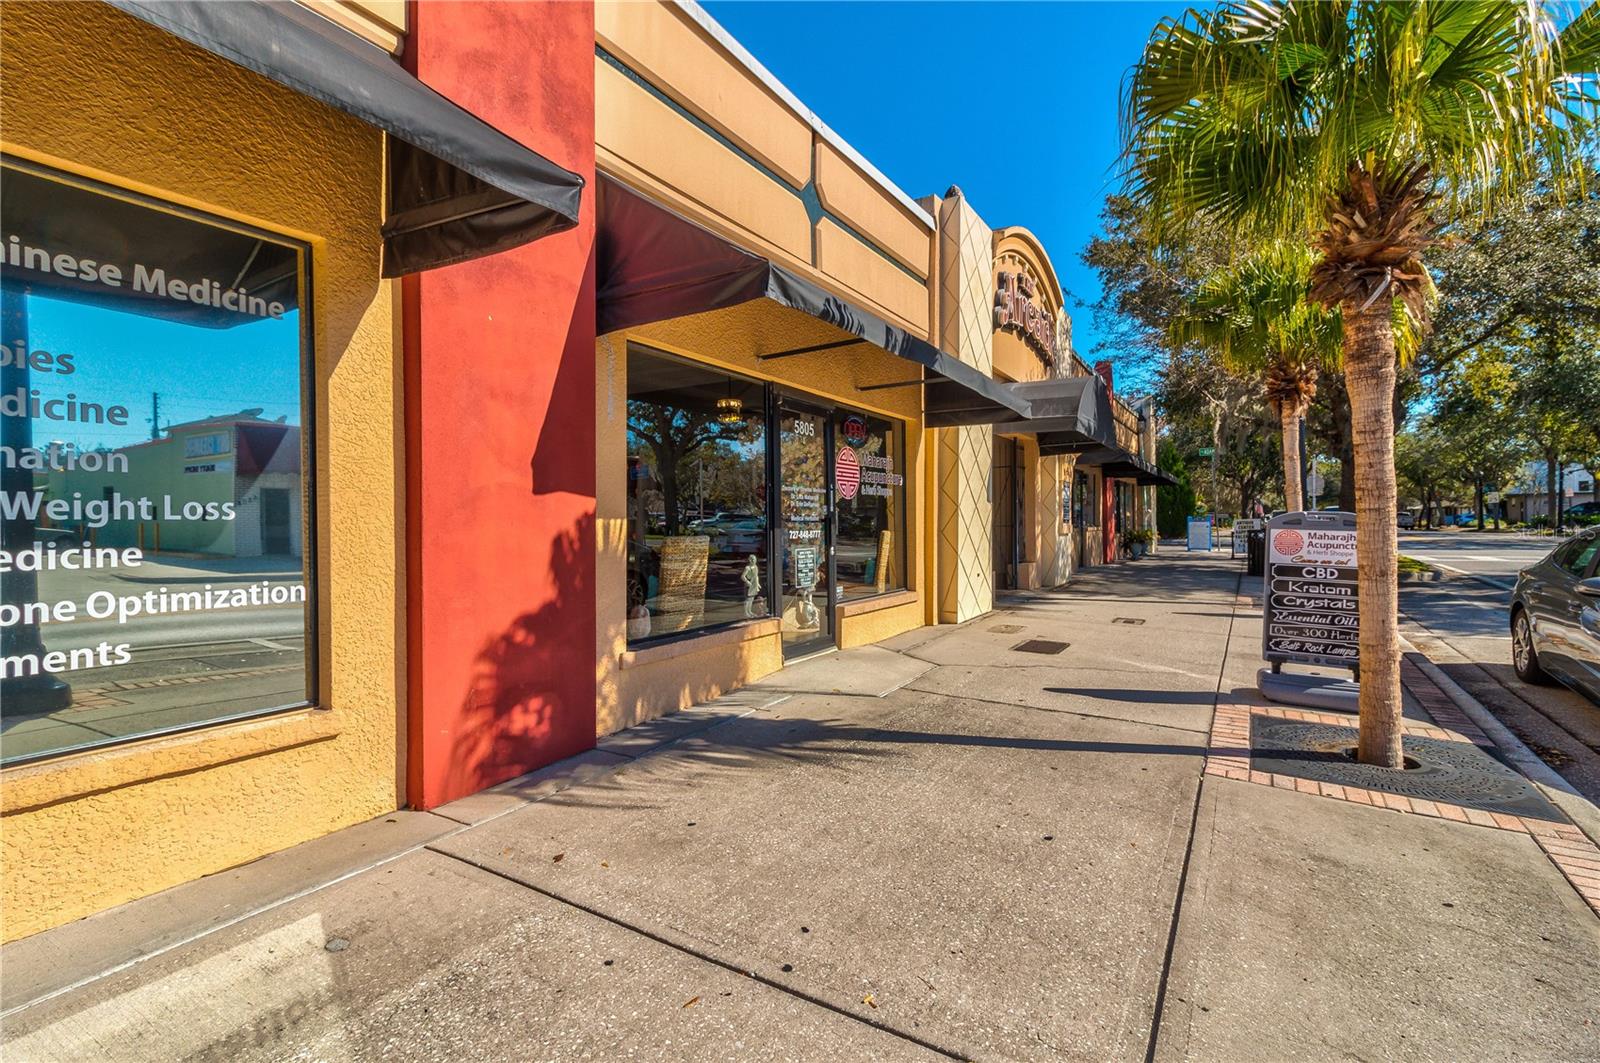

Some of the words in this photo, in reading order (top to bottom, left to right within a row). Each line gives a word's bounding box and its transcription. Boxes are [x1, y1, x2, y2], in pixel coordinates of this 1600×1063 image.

[0, 235, 122, 287] inese
[132, 263, 285, 320] Medicine
[794, 420, 815, 437] 5805
[0, 490, 153, 528] Weight
[164, 494, 236, 521] Loss
[1307, 532, 1357, 543] Maharajh
[1306, 540, 1358, 550] Acupunct
[1302, 567, 1339, 579] CBD
[1288, 581, 1351, 595] Kratom
[86, 580, 307, 624] Optimization
[1283, 596, 1356, 610] Crystals
[1279, 611, 1332, 624] Essential
[1274, 626, 1299, 636] Over
[1302, 628, 1328, 638] 300
[1302, 642, 1325, 653] Rock
[1326, 645, 1357, 656] Lamps
[0, 641, 132, 680] ments
